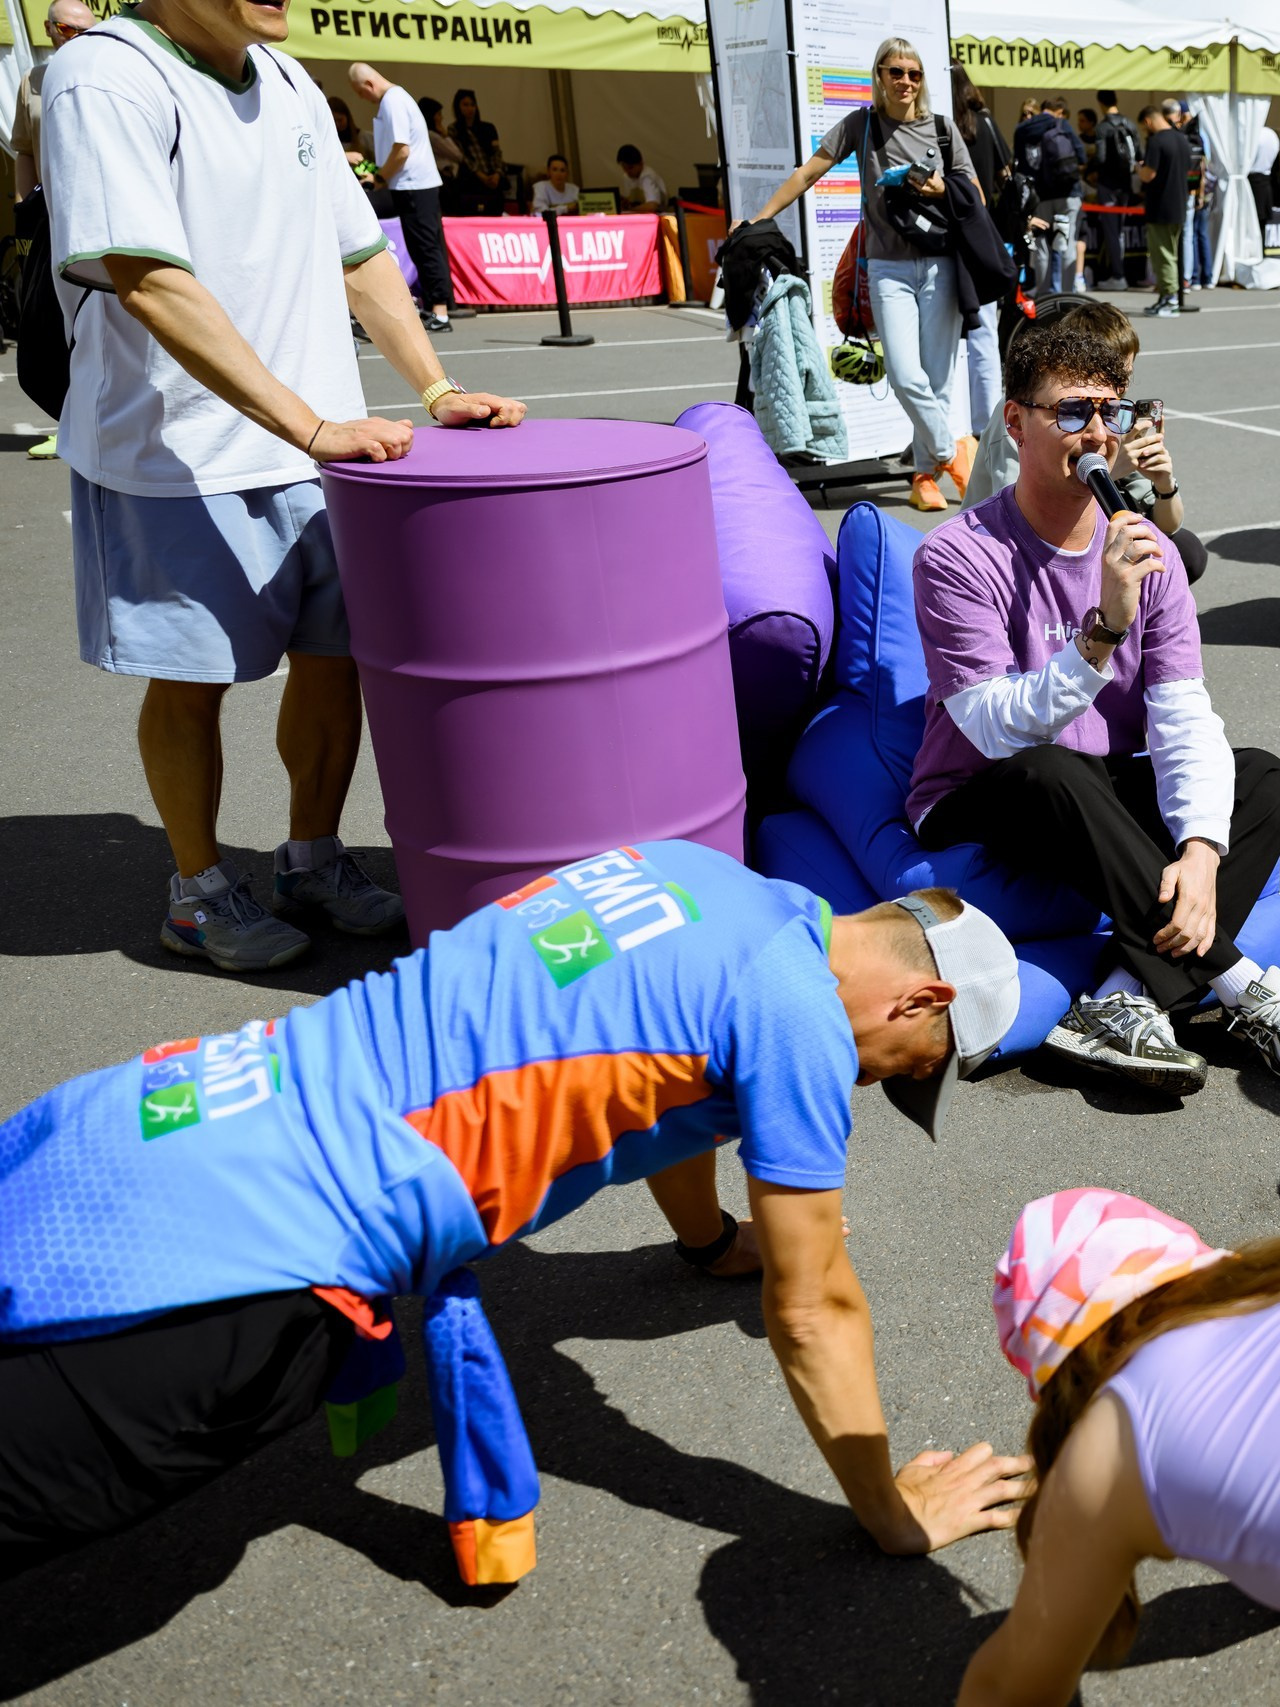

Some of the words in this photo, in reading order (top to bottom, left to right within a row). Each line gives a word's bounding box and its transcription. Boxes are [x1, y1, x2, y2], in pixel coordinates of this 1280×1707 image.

[310, 7, 533, 49] РЕГИСТРАЦИЯ
[478, 232, 540, 264] IRON
[566, 230, 624, 263] LADY
